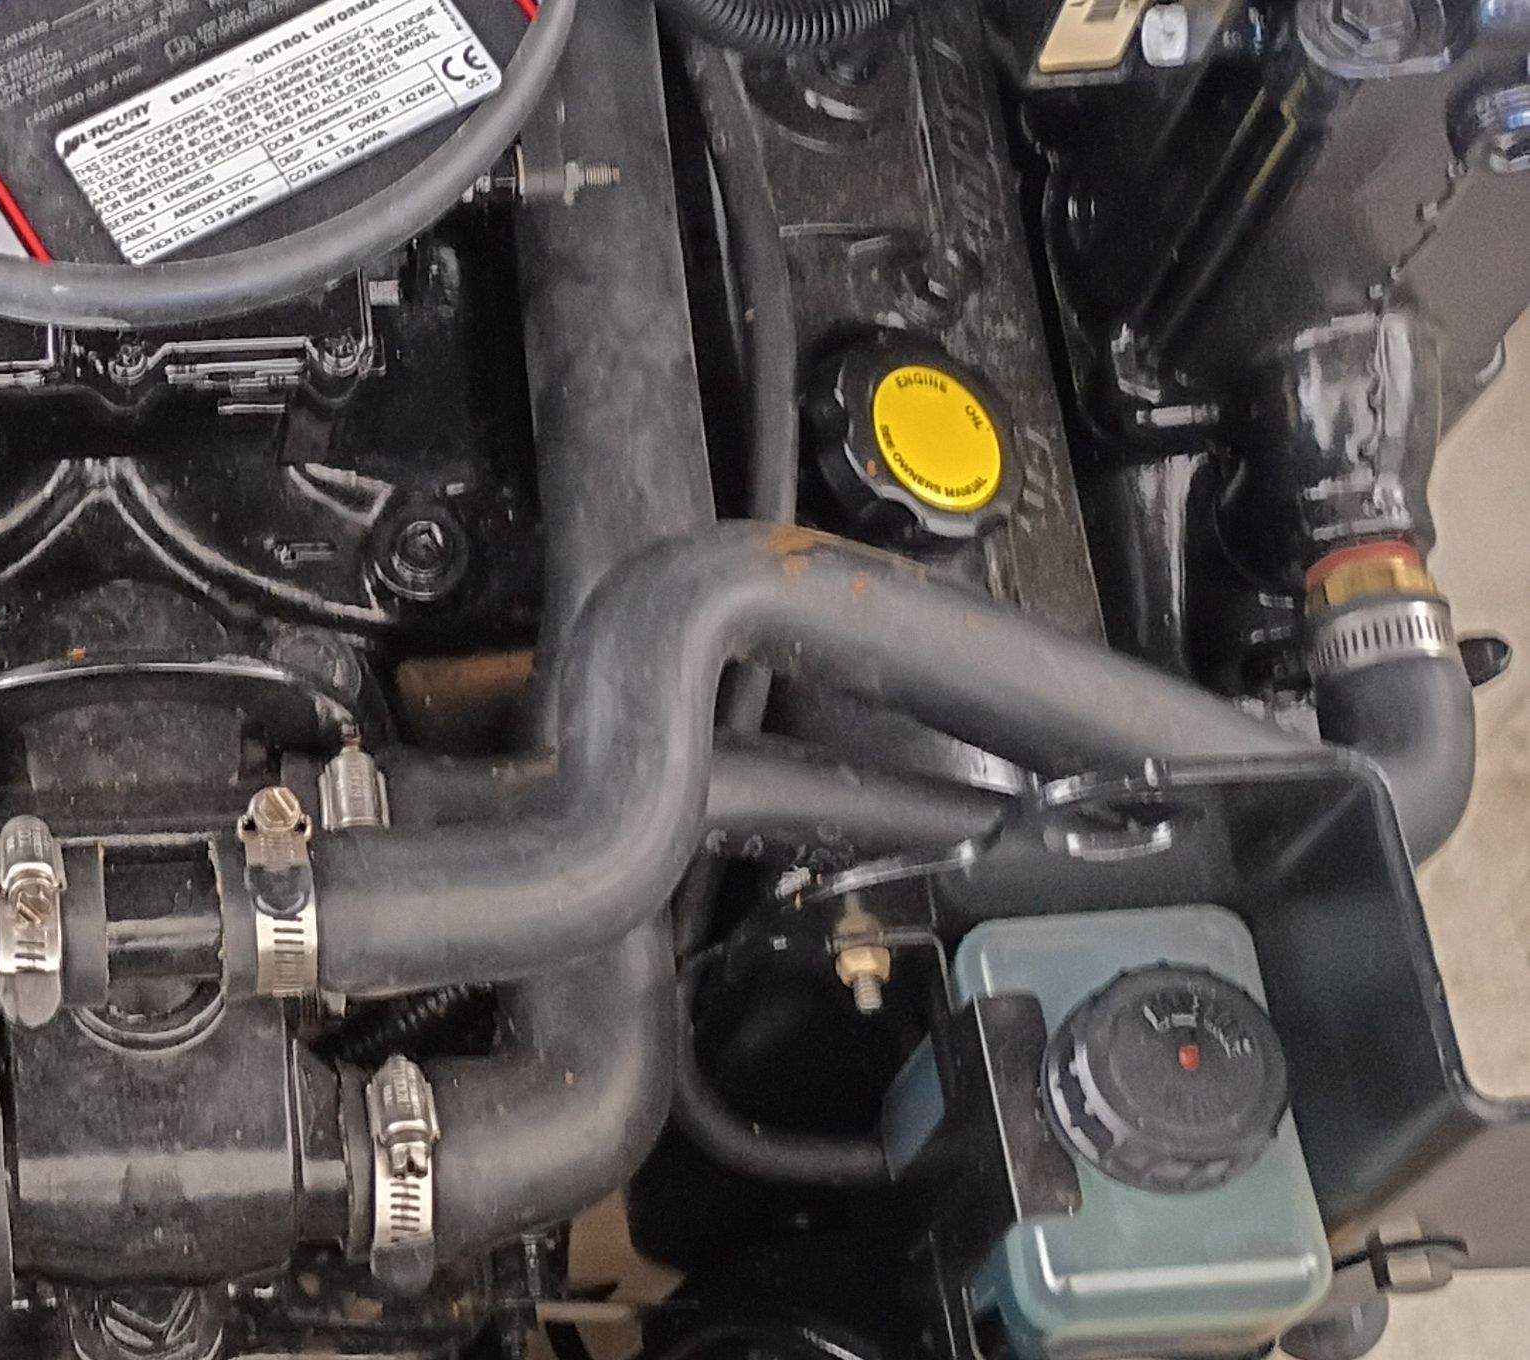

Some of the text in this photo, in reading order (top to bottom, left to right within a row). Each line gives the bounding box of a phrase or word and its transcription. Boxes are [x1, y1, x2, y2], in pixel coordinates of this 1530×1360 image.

[74, 160, 101, 179] THIS
[99, 139, 144, 167] ENGINE
[142, 107, 209, 145] CONFORMS
[208, 98, 227, 112] TO
[319, 24, 375, 57] EMISSION
[78, 144, 159, 190] REGULATIONS
[156, 131, 184, 151] FOR
[182, 112, 223, 138] SPARK
[221, 87, 273, 119] IGNITION
[270, 65, 316, 94] MARINE
[368, 25, 396, 45] THIS
[393, 5, 438, 32] ENGINE
[463, 69, 494, 91] 0575
[61, 100, 154, 157] MERCURY
[85, 21, 429, 199] IS EXEMPT UNDER 40 CFR FROM EMISSION STANDARDS
[90, 28, 441, 209] AND RELATED REFER TO THE OWNERS MANUAL
[297, 89, 382, 138] September 2010
[314, 131, 339, 149] 4.3L
[346, 104, 392, 133] POWER
[397, 91, 419, 108] 142
[416, 81, 438, 98] kW
[97, 199, 124, 218] FOR
[122, 159, 204, 205] MAINTENANCE
[201, 113, 296, 166] SPECIFICATIONS
[293, 101, 321, 120] AND
[286, 167, 309, 184] CO
[305, 157, 329, 174] FEL
[334, 144, 355, 160] 135
[106, 206, 149, 232] SERIAL
[162, 172, 216, 204] 1A628826
[172, 223, 196, 241] FEL
[200, 208, 226, 227] 13.9
[116, 221, 159, 247] FAMILY
[894, 372, 948, 393] ENGINE
[964, 404, 985, 431] OIL
[879, 423, 988, 498] SEE OWNERS MANUAL
